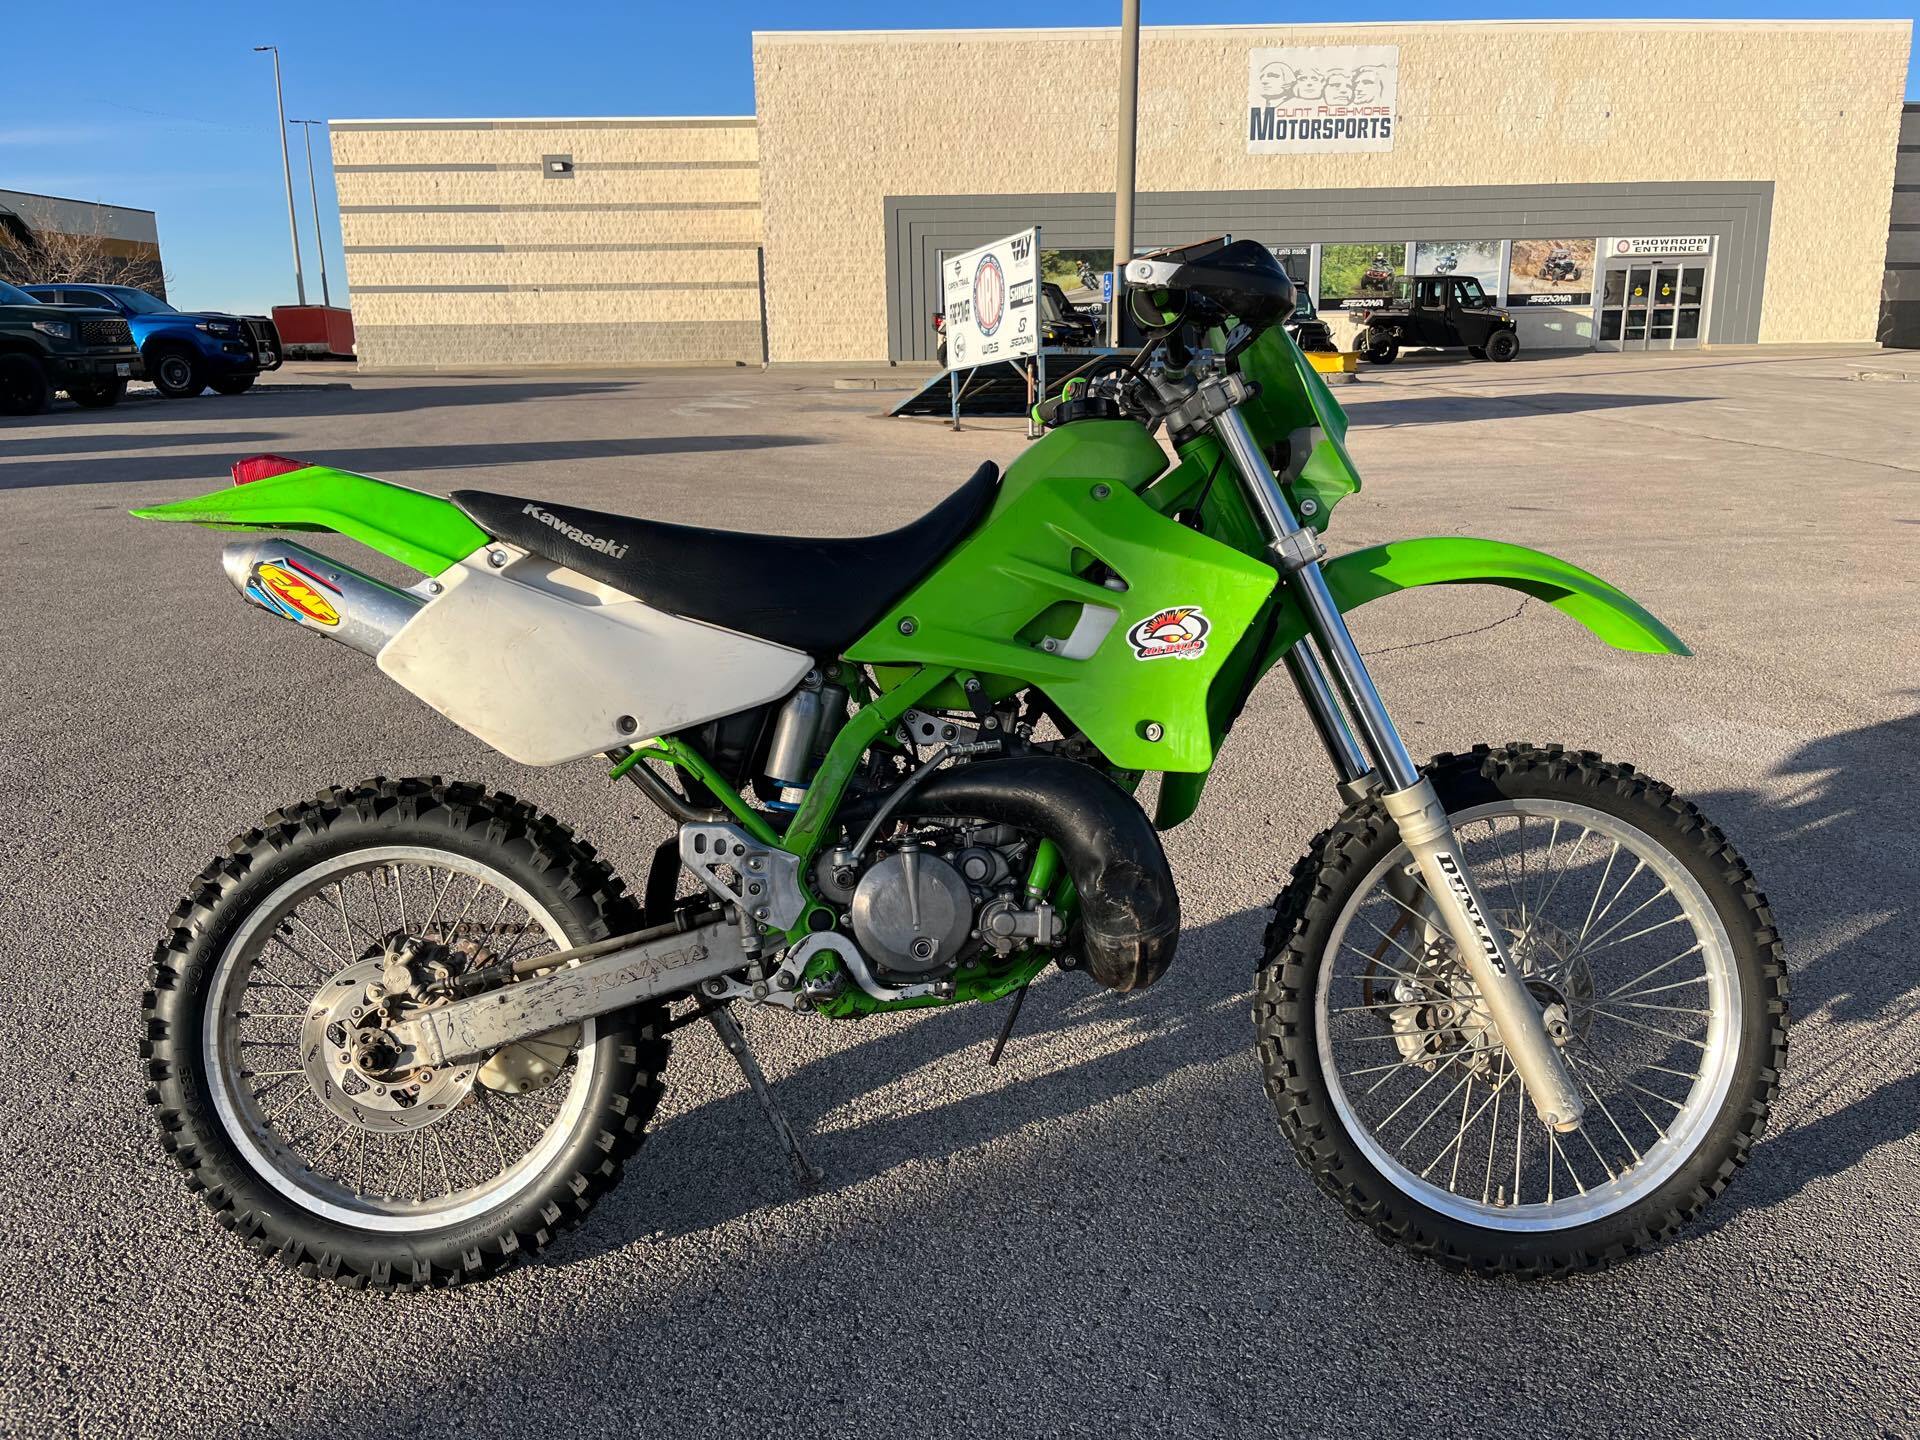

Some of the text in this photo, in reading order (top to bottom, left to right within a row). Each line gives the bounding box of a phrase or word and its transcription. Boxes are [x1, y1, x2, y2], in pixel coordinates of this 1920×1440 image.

[1250, 107, 1391, 141] MOTORSPORTS
[1632, 238, 1708, 246] SHOWROOM
[1634, 245, 1704, 253] ENTRANCE
[1339, 299, 1384, 308] SEDONA
[1528, 294, 1572, 303] SEDONA
[1009, 334, 1034, 348] SEDONA
[521, 503, 630, 560] Kawasaki
[1437, 854, 1507, 975] DUNLOP
